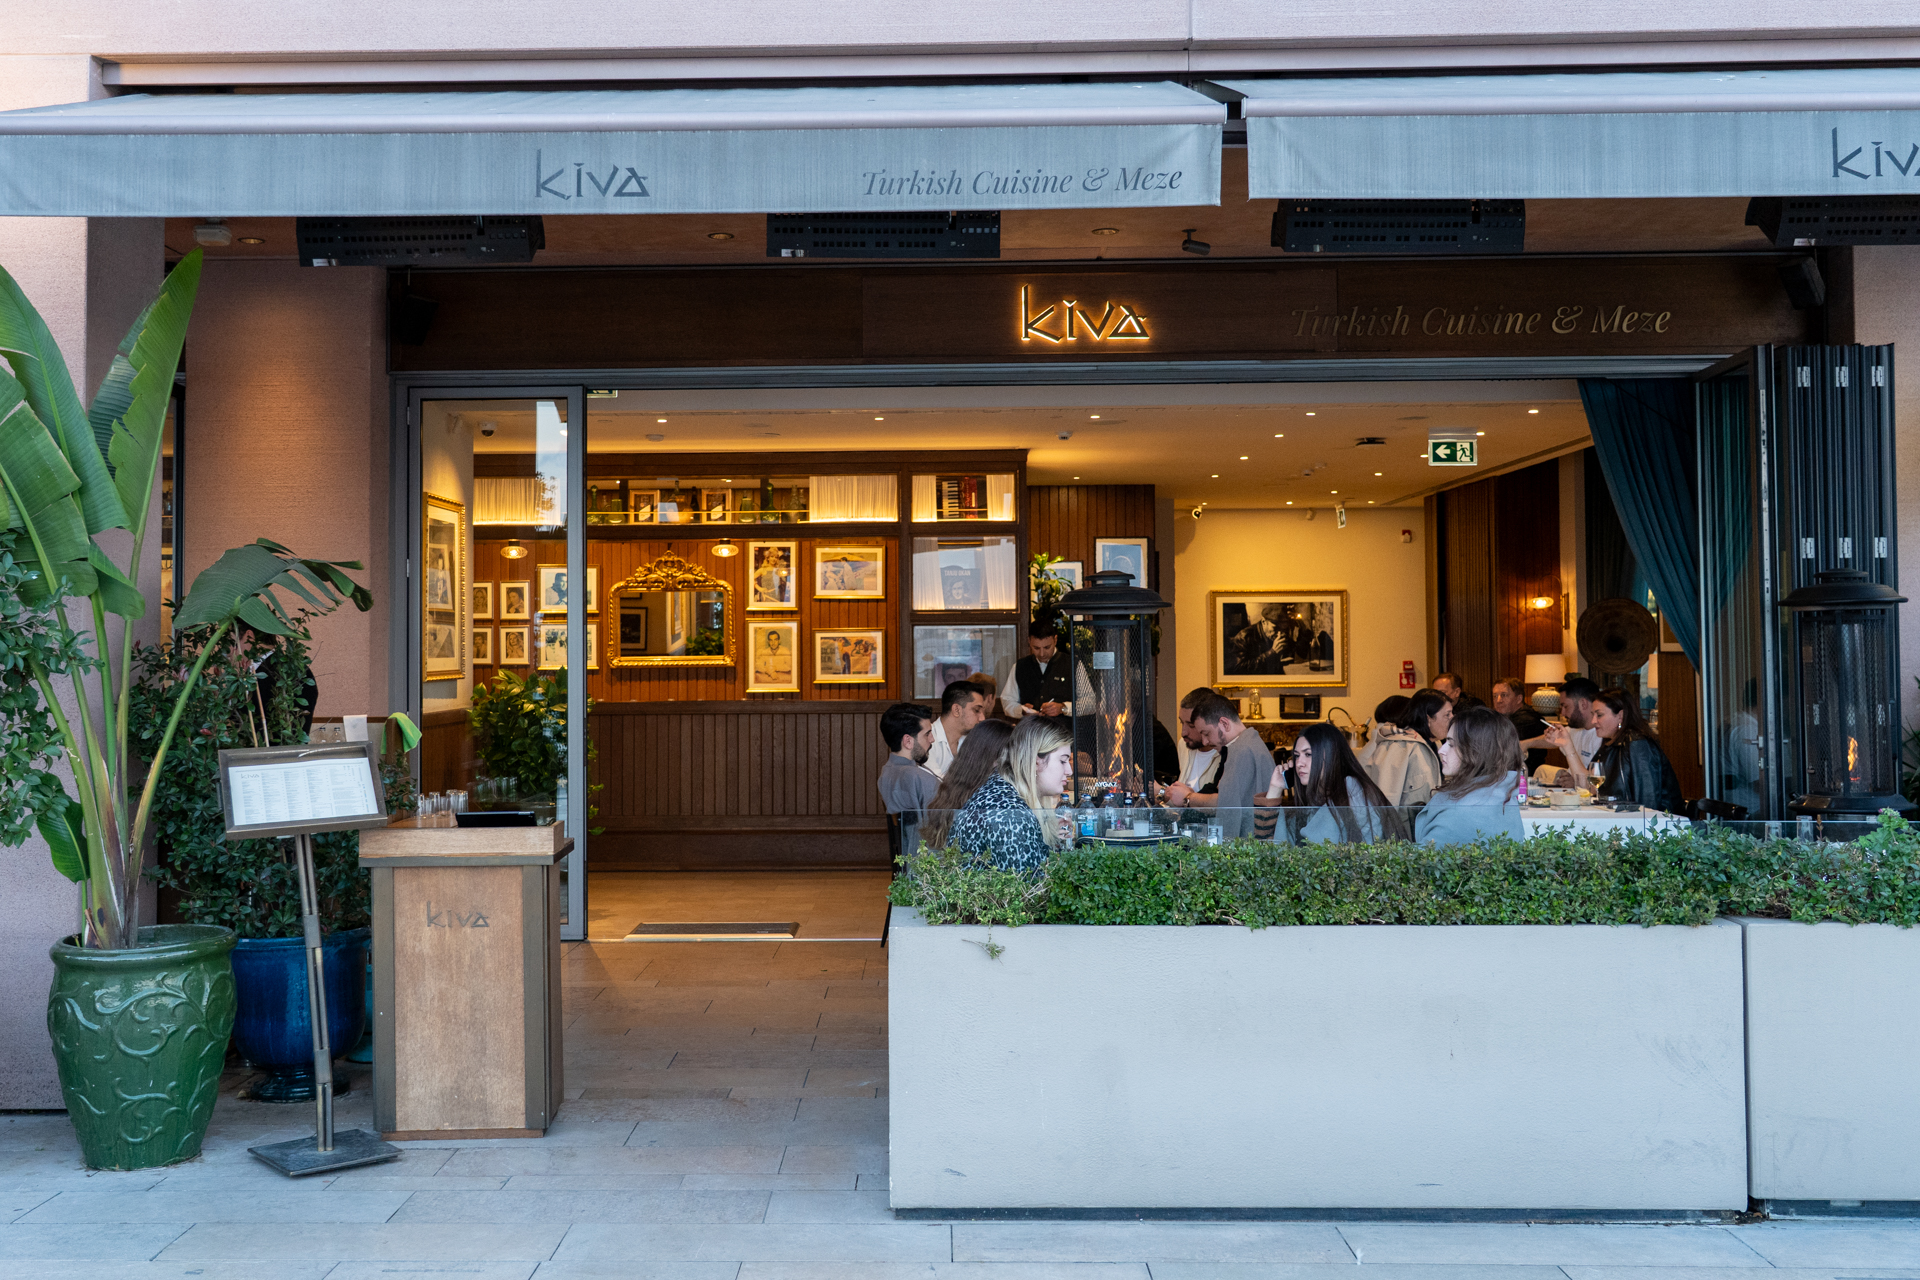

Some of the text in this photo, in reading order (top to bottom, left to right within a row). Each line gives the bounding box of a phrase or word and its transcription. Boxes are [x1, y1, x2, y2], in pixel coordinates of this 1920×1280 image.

[862, 166, 1183, 196] Turkish Cuisine & Meze
[1291, 304, 1672, 337] Turkish Cuisine & Meze
